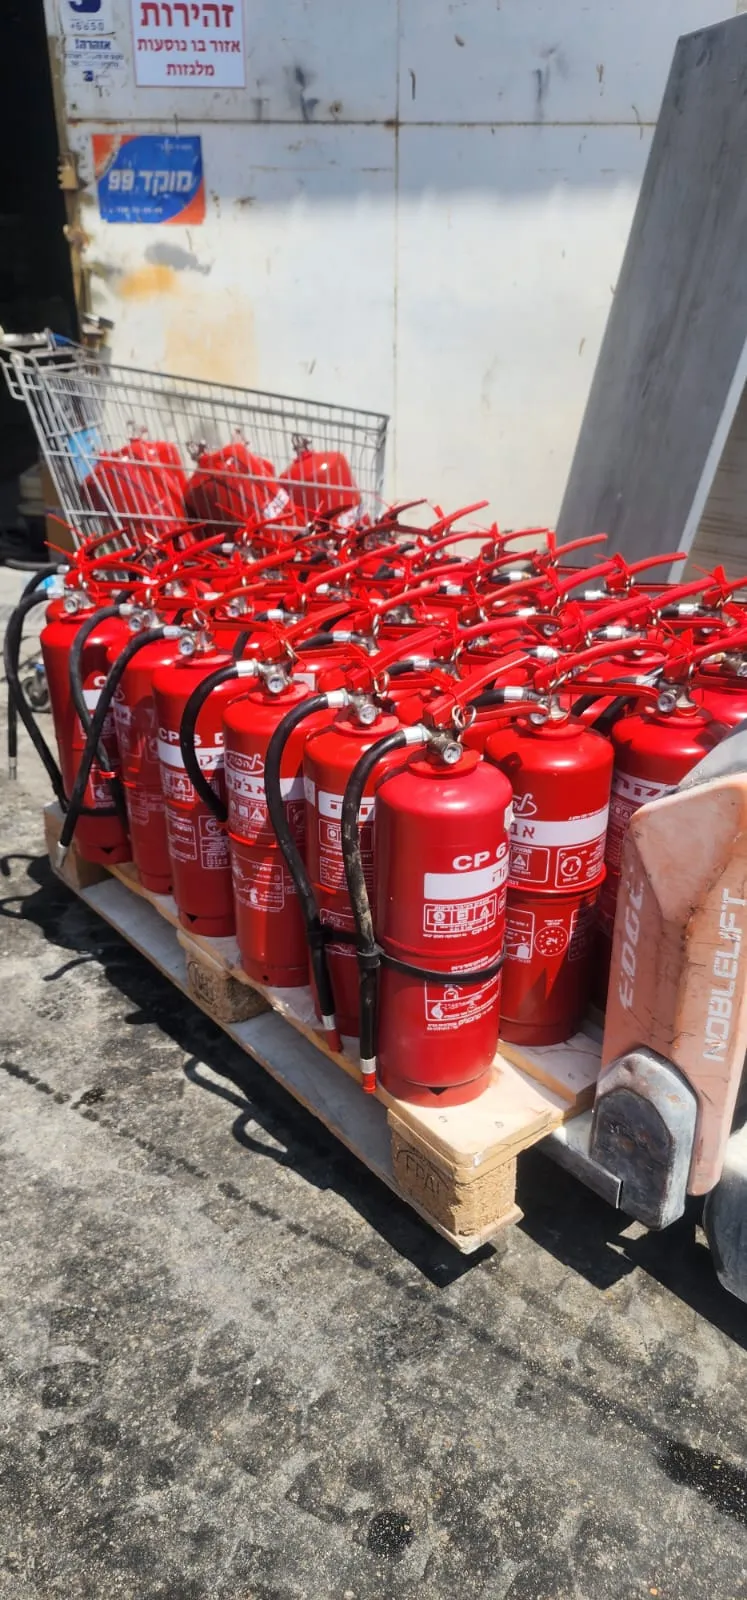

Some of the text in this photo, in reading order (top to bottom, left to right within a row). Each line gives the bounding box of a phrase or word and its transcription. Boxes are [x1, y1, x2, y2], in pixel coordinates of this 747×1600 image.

[140, 2, 234, 28] זהירות
[137, 39, 241, 53] אזור בו נוסעות
[166, 60, 215, 76] מלגזות
[108, 169, 193, 197] מוקד 99
[452, 850, 491, 871] CP
[495, 842, 507, 859] 6
[702, 887, 747, 1062] NOBLELIFT
